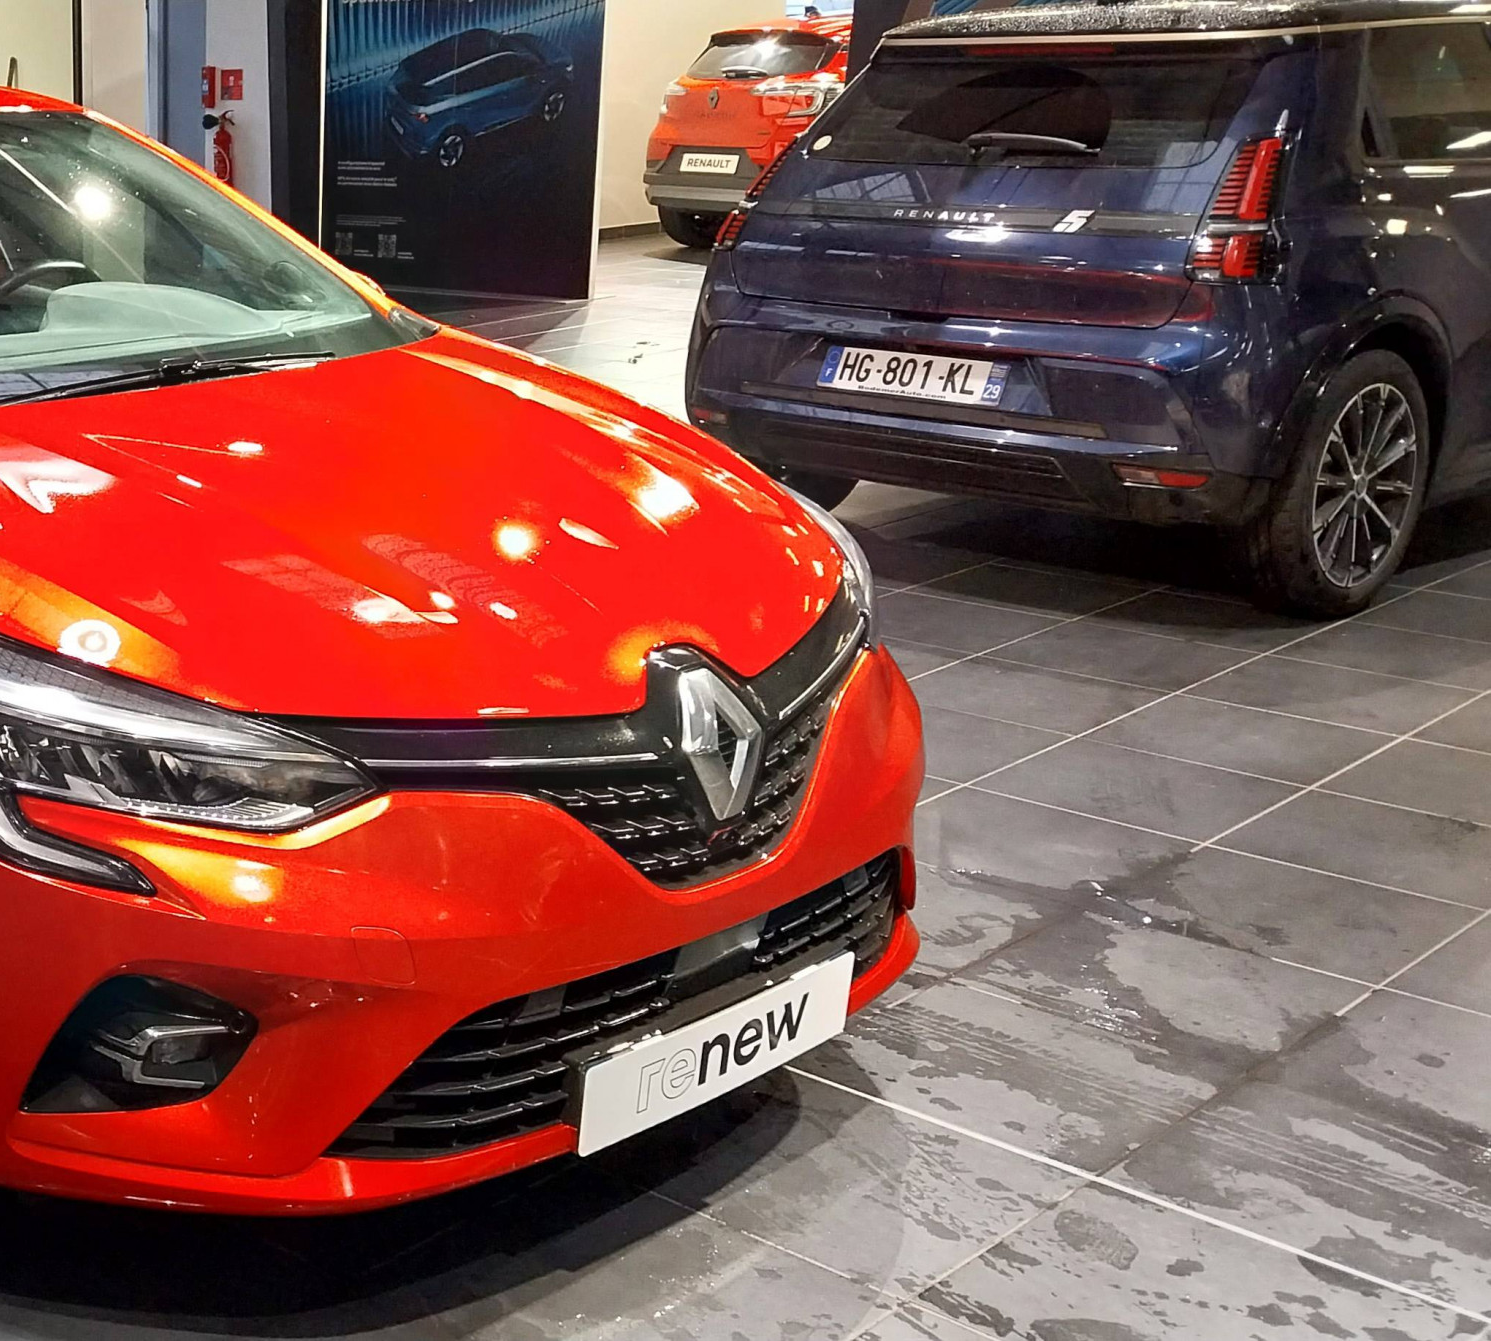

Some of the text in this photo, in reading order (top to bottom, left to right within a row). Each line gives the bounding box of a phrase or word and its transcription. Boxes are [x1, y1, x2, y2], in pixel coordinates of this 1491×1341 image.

[686, 158, 732, 169] RENAULT
[893, 209, 1096, 234] RENAULT 5
[825, 367, 833, 377] F
[838, 352, 975, 395] HG-801-KL
[983, 384, 1001, 399] 29
[636, 992, 810, 1114] renew
